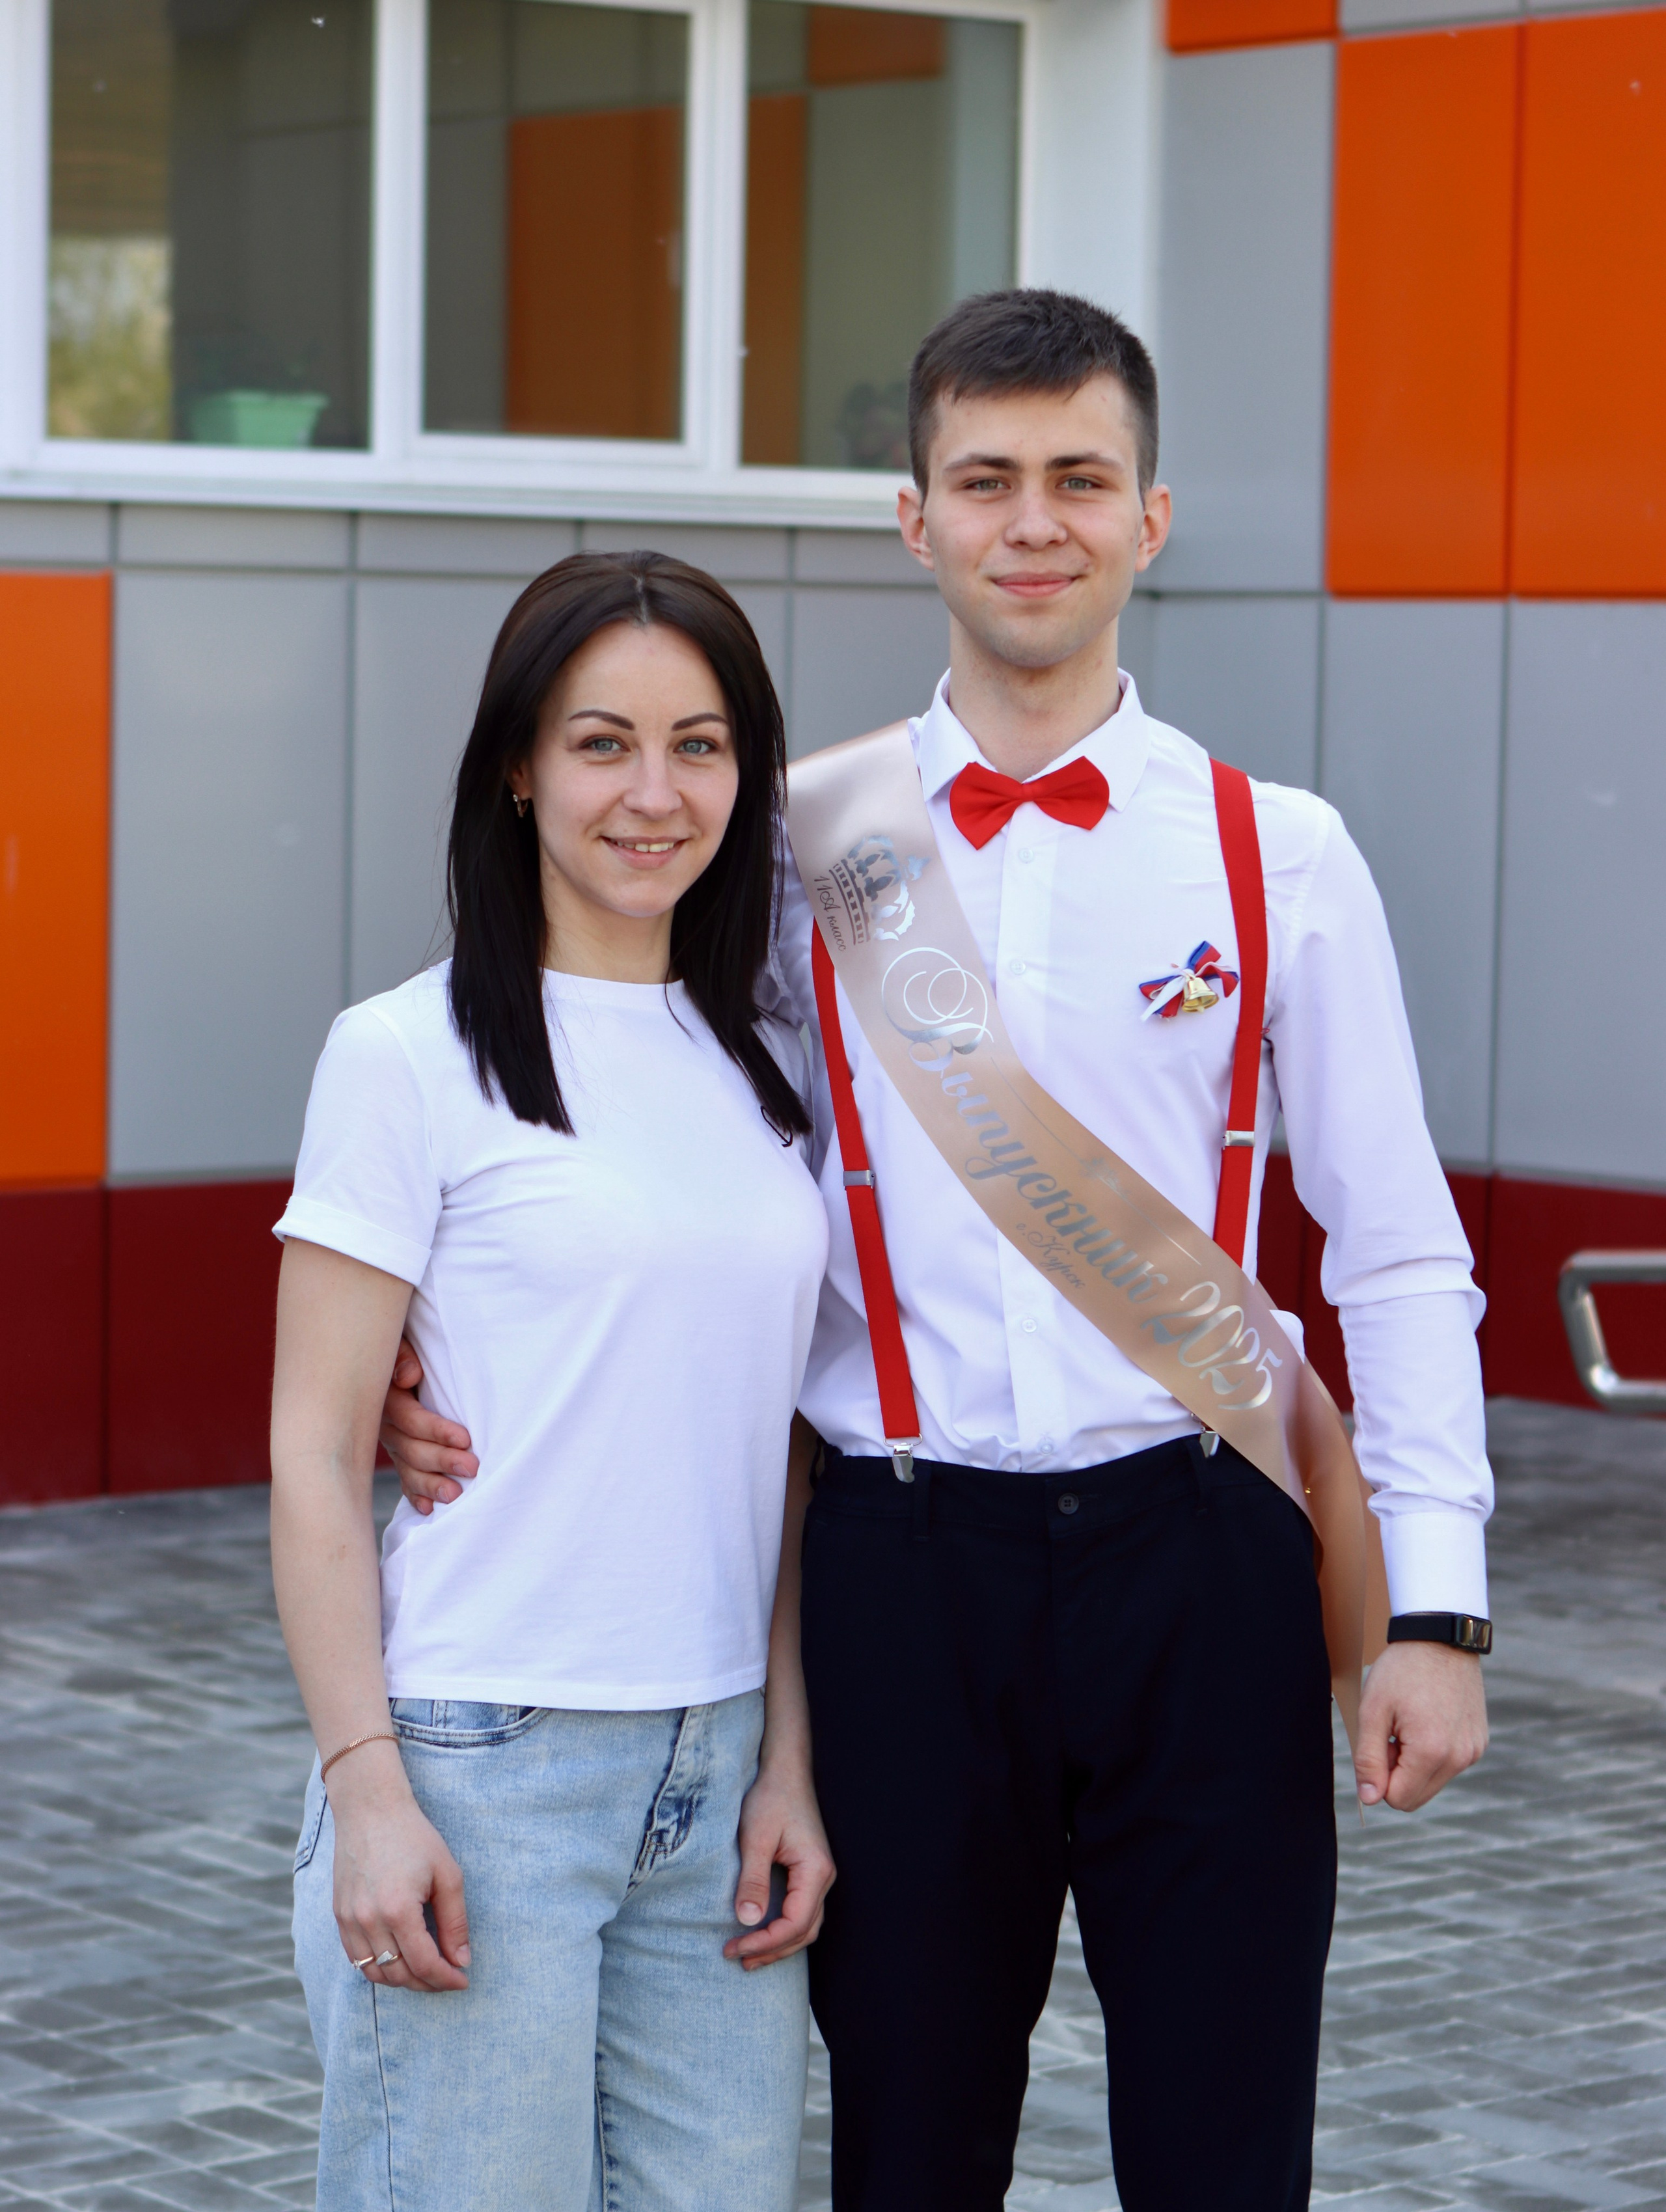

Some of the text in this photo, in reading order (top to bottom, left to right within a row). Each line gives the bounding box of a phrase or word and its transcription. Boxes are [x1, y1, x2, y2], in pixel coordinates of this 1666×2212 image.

[827, 915, 846, 951] класс
[881, 946, 1283, 1411] Выпускник 2025
